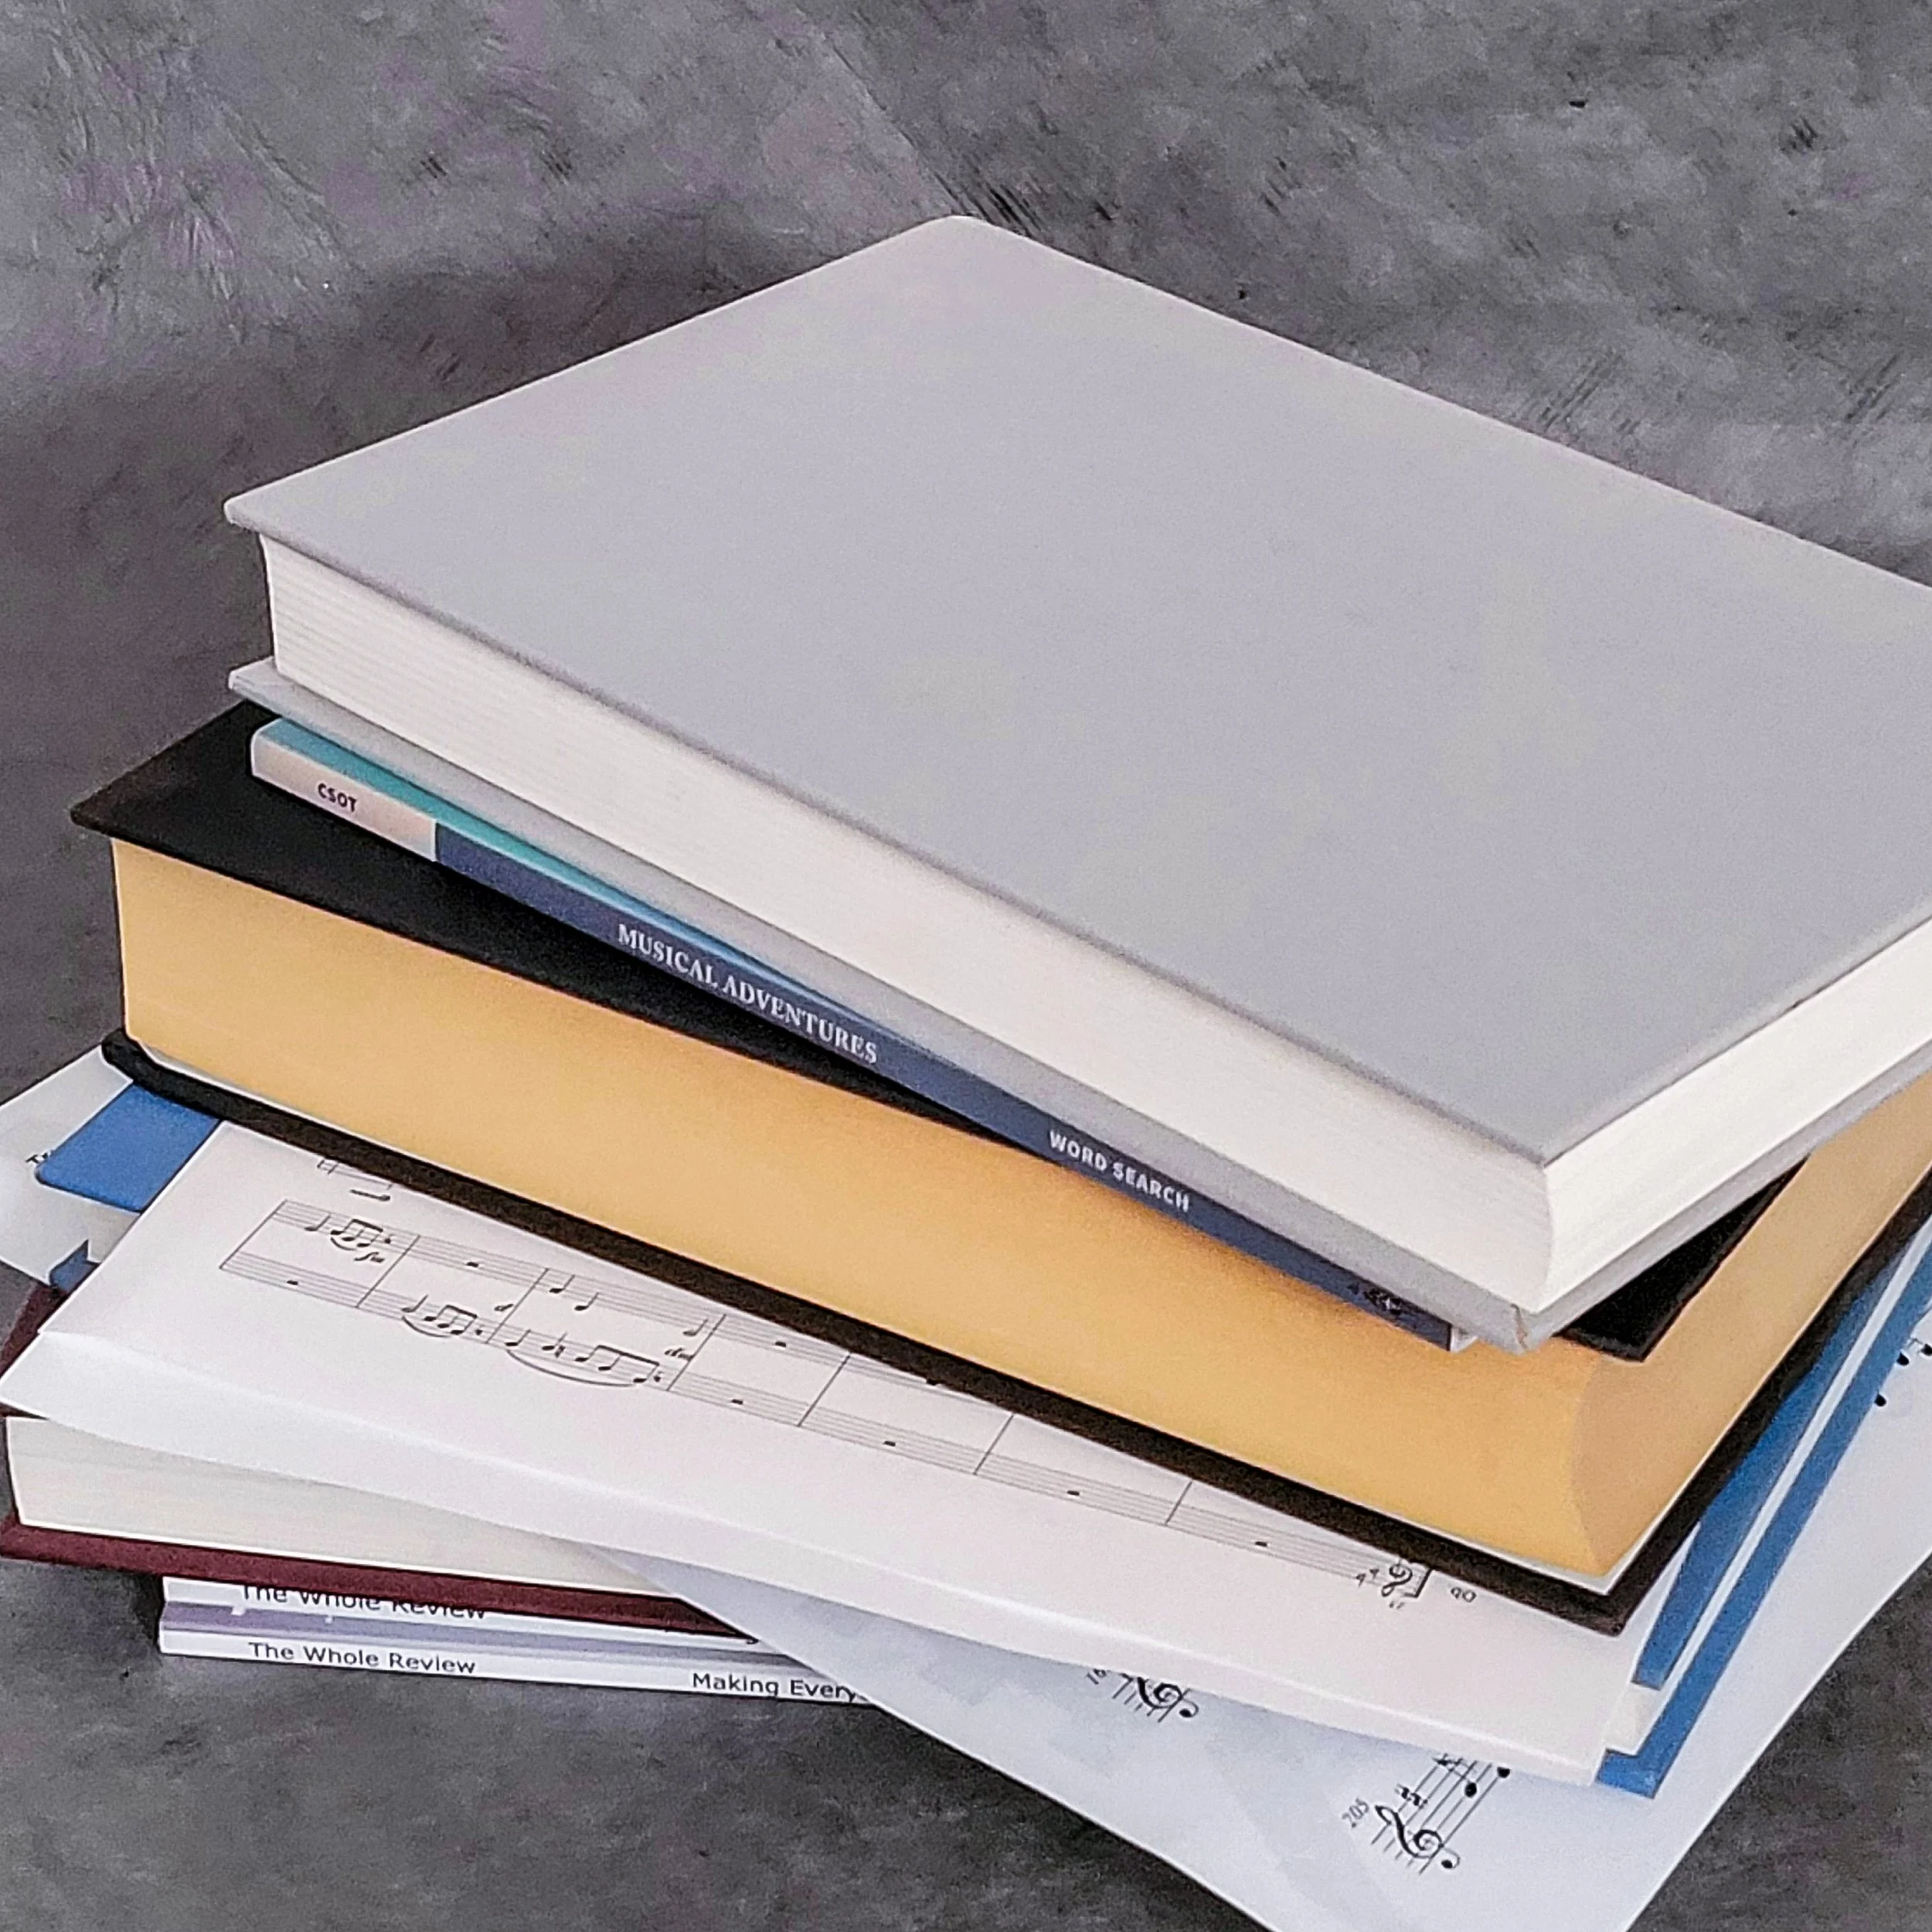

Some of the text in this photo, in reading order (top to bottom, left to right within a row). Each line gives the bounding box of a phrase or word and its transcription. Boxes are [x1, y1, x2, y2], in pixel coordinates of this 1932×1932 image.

[318, 783, 357, 812] CSOT
[617, 923, 879, 1065] MUSICAL ADVENTURES
[1048, 1130, 1191, 1212] WORD SEARCH
[248, 1641, 477, 1674] The Whole Review
[692, 1672, 780, 1697] Making
